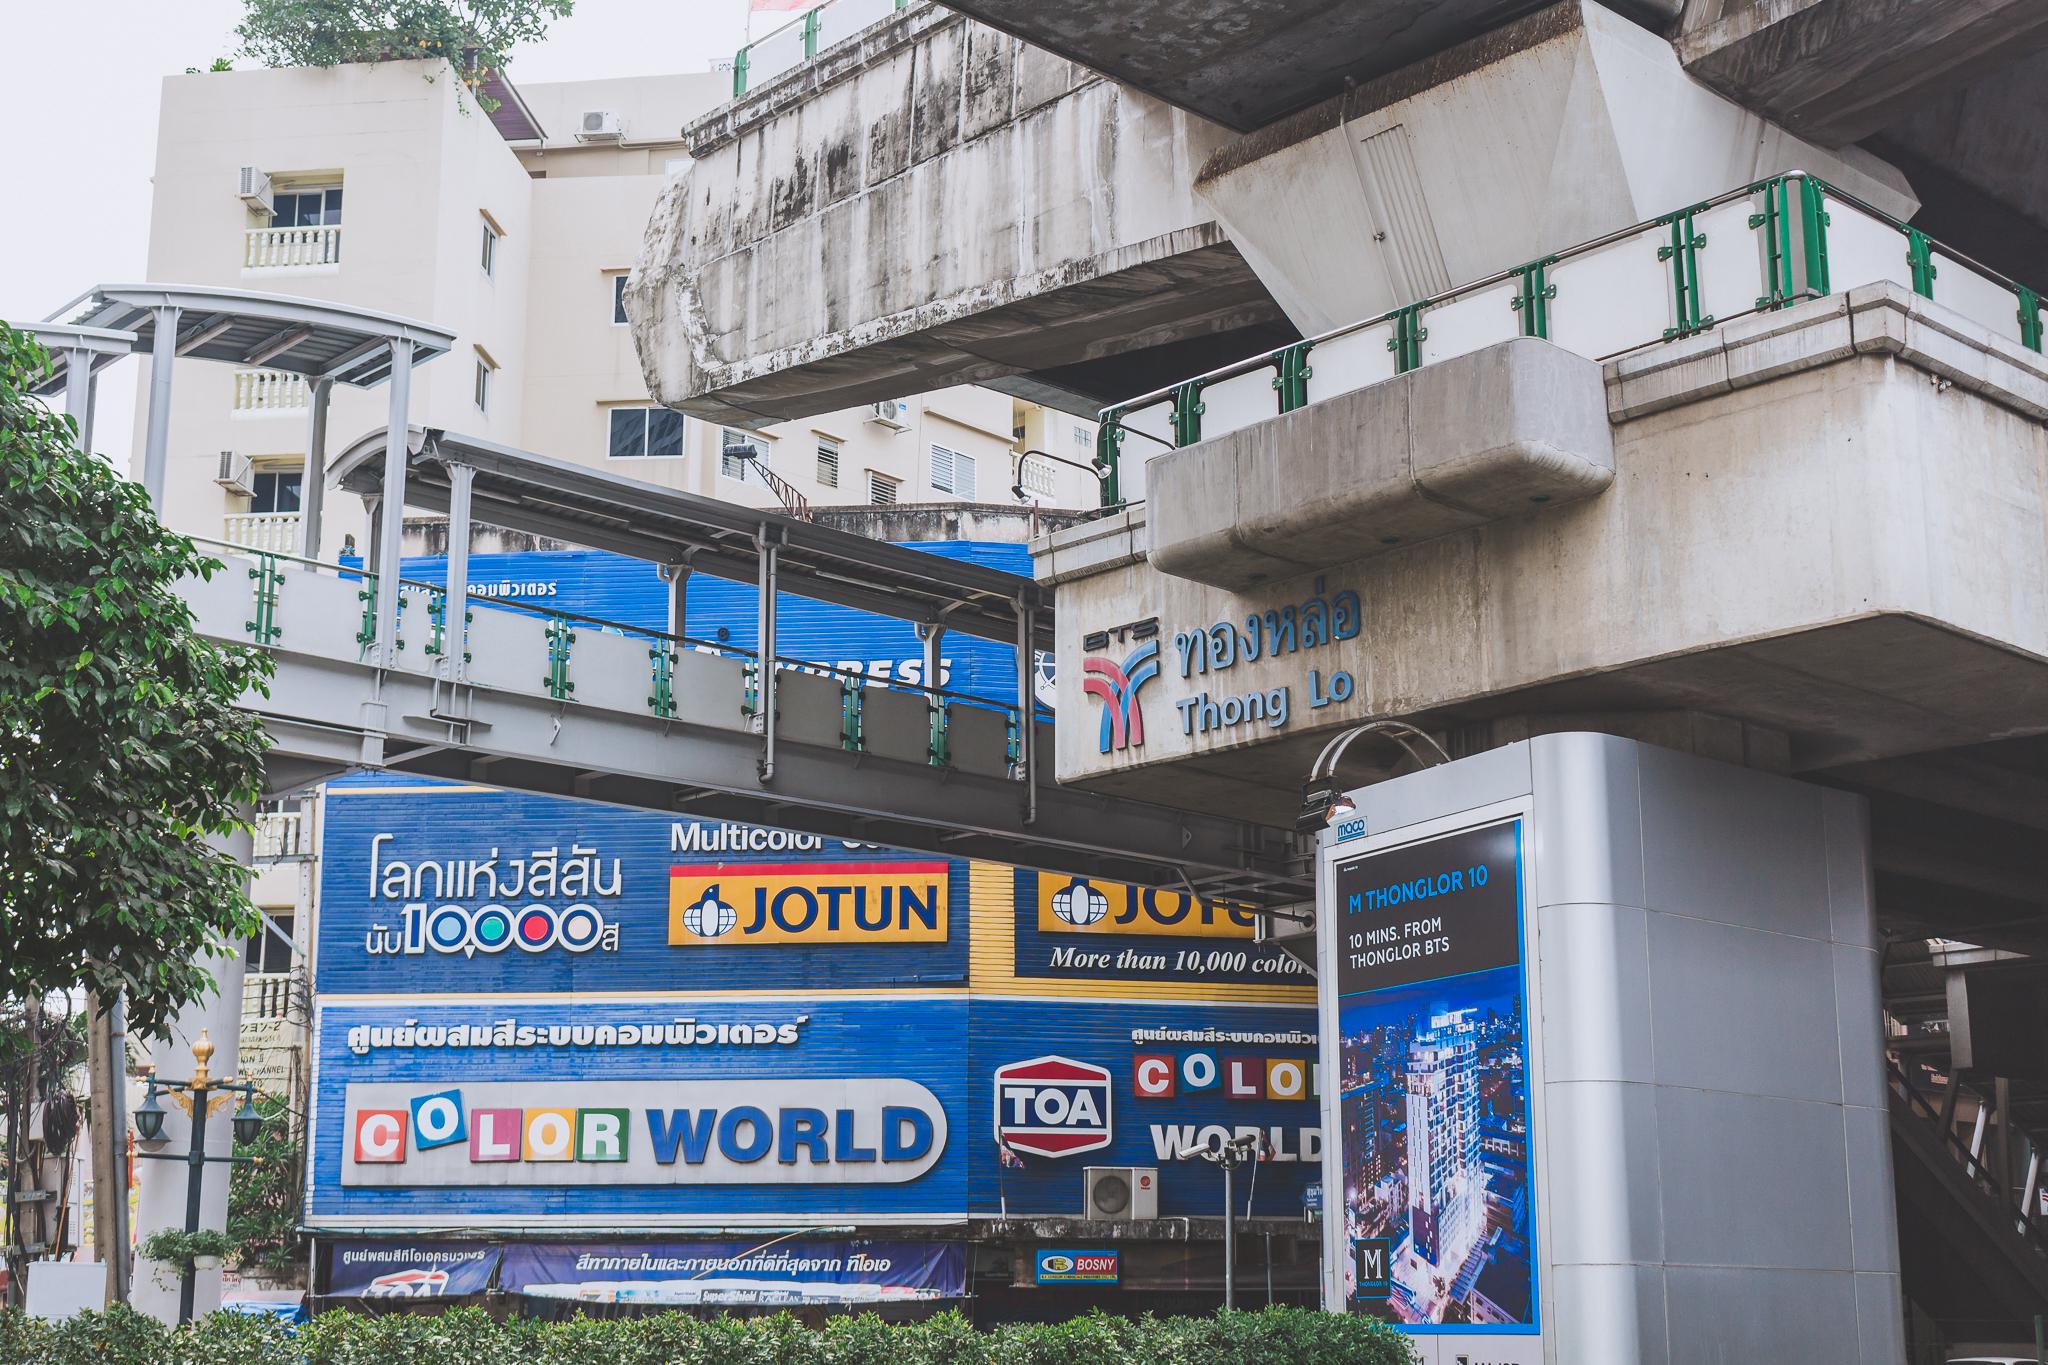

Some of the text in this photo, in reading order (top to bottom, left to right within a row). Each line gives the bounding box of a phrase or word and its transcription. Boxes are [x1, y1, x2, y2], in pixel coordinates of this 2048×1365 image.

[1083, 616, 1159, 651] BTS
[1175, 575, 1361, 678] ทองหล่อ
[1175, 670, 1354, 735] Thong Lo
[369, 833, 622, 898] โลกแห่งสีสัน
[1349, 864, 1488, 914] M THONGLOR 10
[743, 885, 938, 935] JOTUN
[1349, 917, 1442, 949] 10 MINS. FROM
[1049, 946, 1110, 969] More
[1116, 948, 1166, 970] than
[1173, 950, 1247, 974] 10,000
[1350, 936, 1450, 969] THONGLOR BTS
[347, 1015, 808, 1054] ศูนย์ผสมสีระบบคอมพิวเตอร์
[1131, 1026, 1320, 1045] ศูนย์ผสมสีระบบคอมพิวเ
[1004, 1087, 1102, 1126] TOA
[360, 1095, 934, 1164] COLOR WORLD
[847, 1253, 891, 1272] ทีโอเอ
[1077, 1258, 1115, 1271] BOSNY
[1363, 1249, 1383, 1279] M
